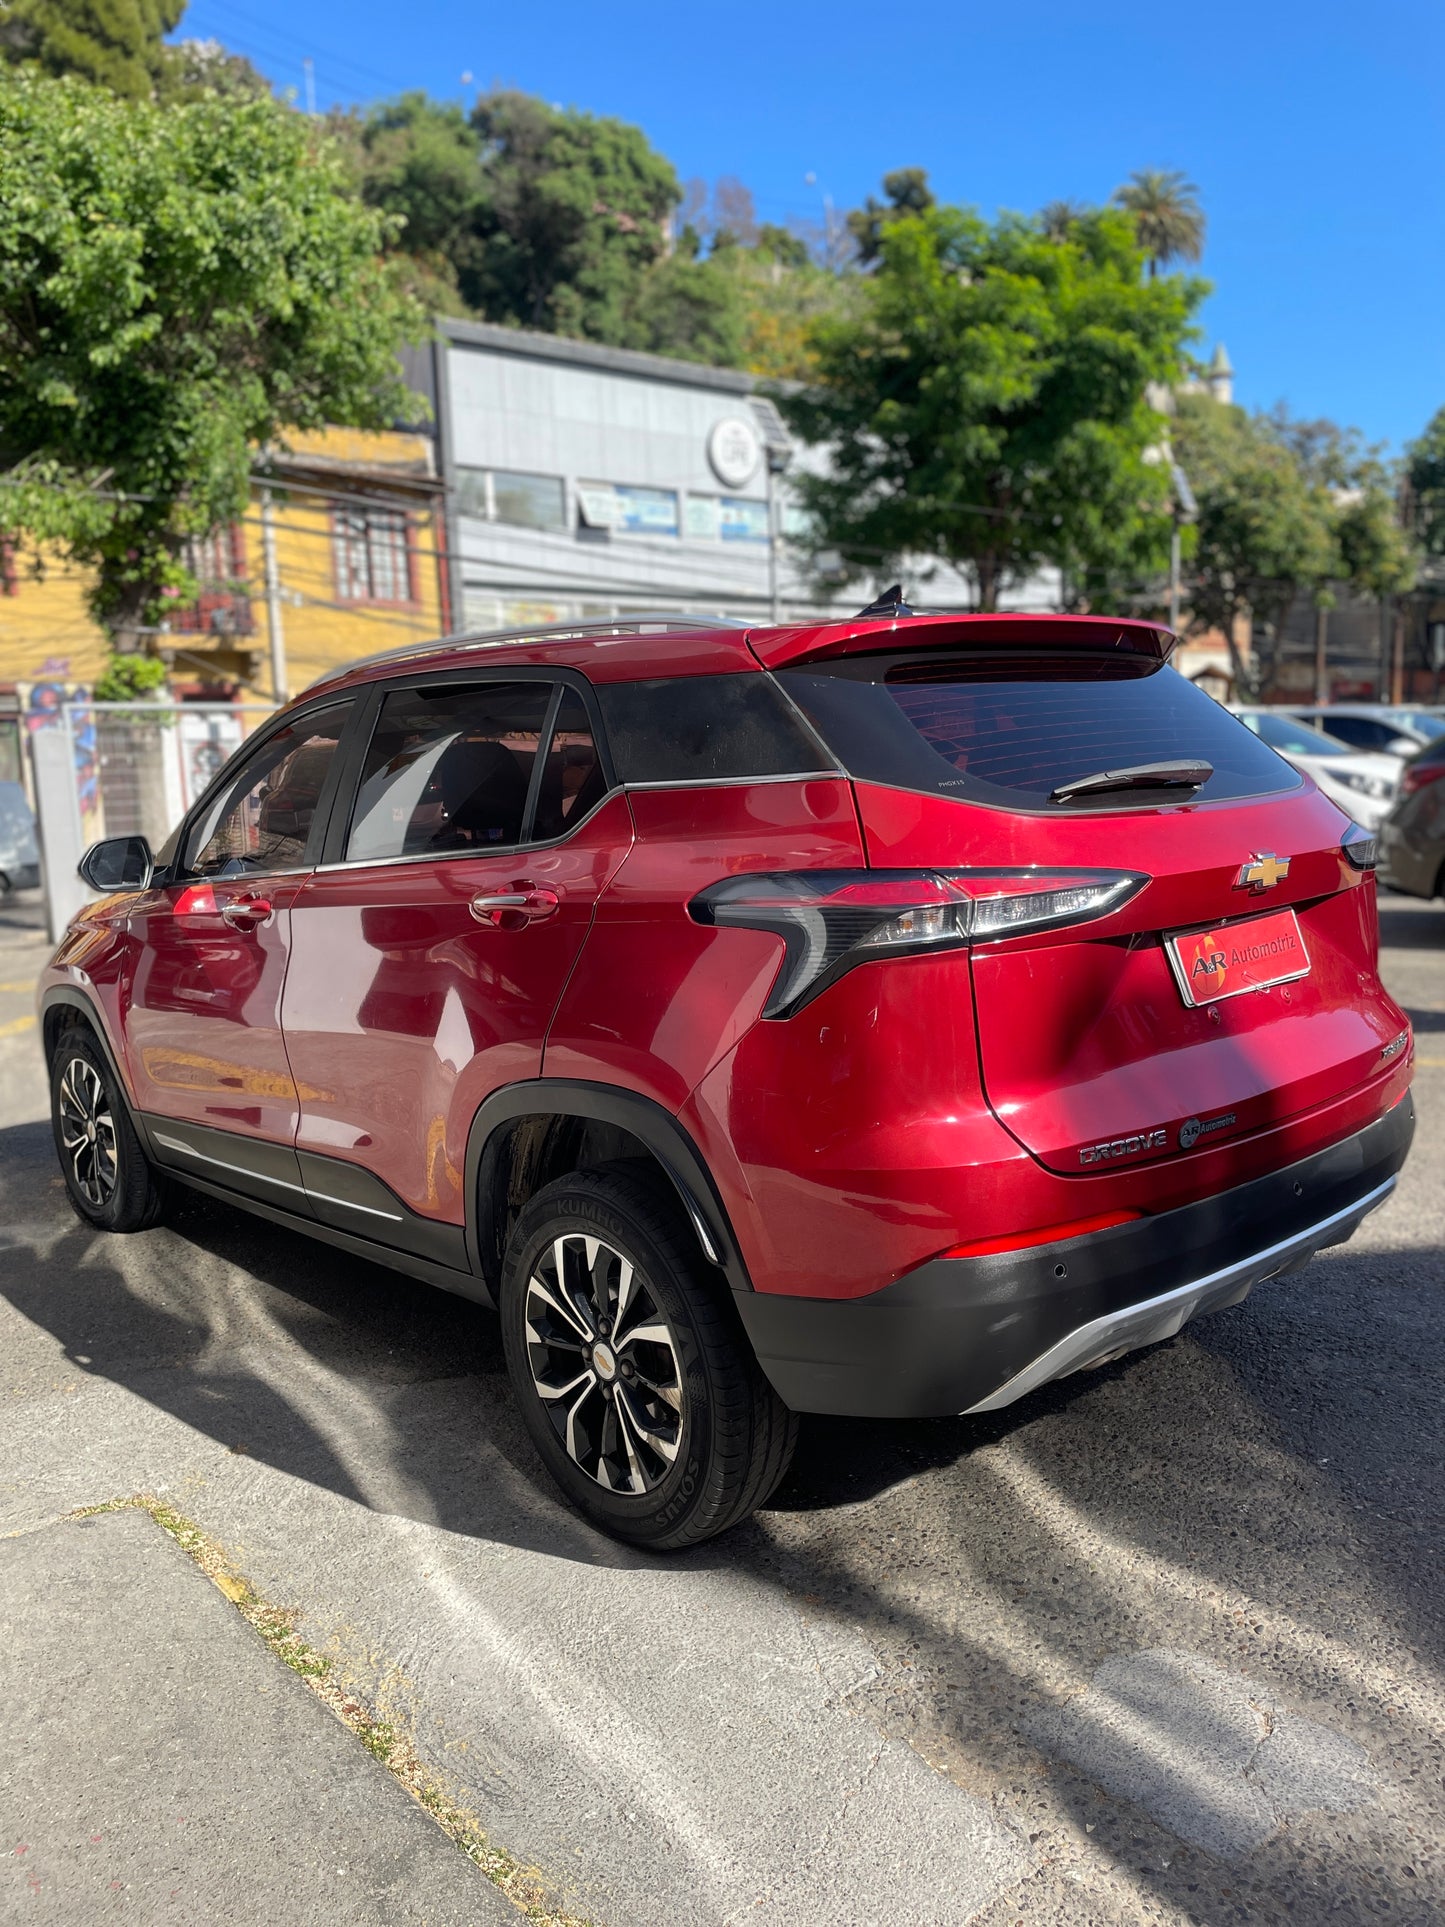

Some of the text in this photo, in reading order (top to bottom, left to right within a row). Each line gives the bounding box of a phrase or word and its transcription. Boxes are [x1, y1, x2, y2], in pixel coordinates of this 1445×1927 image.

[1192, 933, 1296, 979] A&R Automotriz
[1200, 1114, 1236, 1134] Automotriz
[1080, 1129, 1167, 1164] GROOVE
[556, 1198, 625, 1235] KUMHO
[655, 1457, 699, 1527] SOLUS
